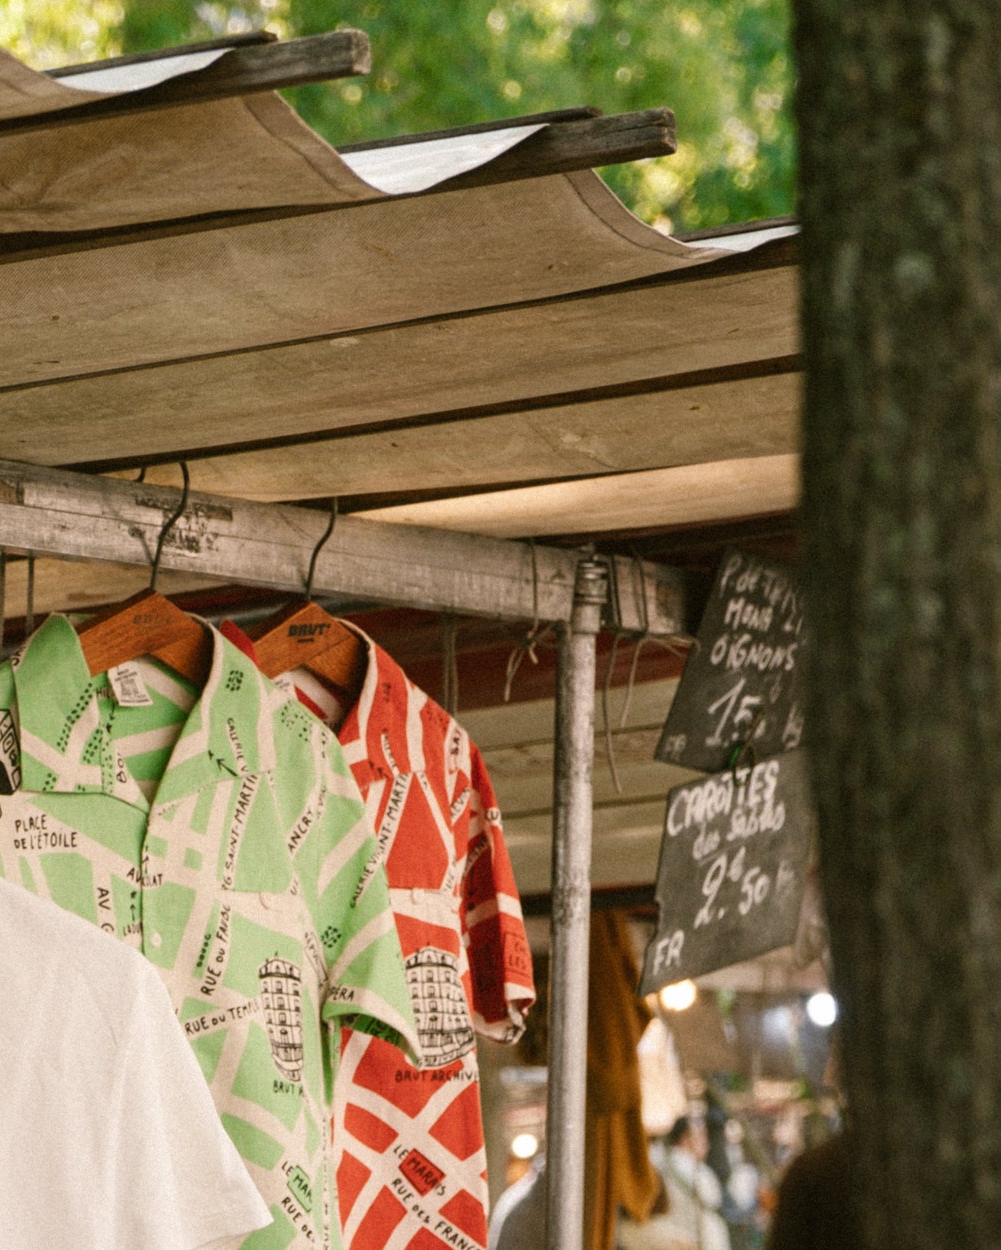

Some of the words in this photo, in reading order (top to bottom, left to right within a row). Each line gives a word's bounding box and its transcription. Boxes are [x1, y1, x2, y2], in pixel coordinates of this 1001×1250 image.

[15, 814, 48, 833] PLACE
[13, 837, 27, 850] DE
[201, 966, 221, 997] RUE
[184, 1017, 210, 1035] RUE
[395, 1070, 427, 1083] BRUT
[273, 1080, 296, 1095] BRUT
[280, 1161, 295, 1177] LE
[393, 1145, 408, 1160] LE
[407, 1156, 446, 1196] MARAIS
[391, 1178, 412, 1202] RUE
[280, 1196, 303, 1227] RUE
